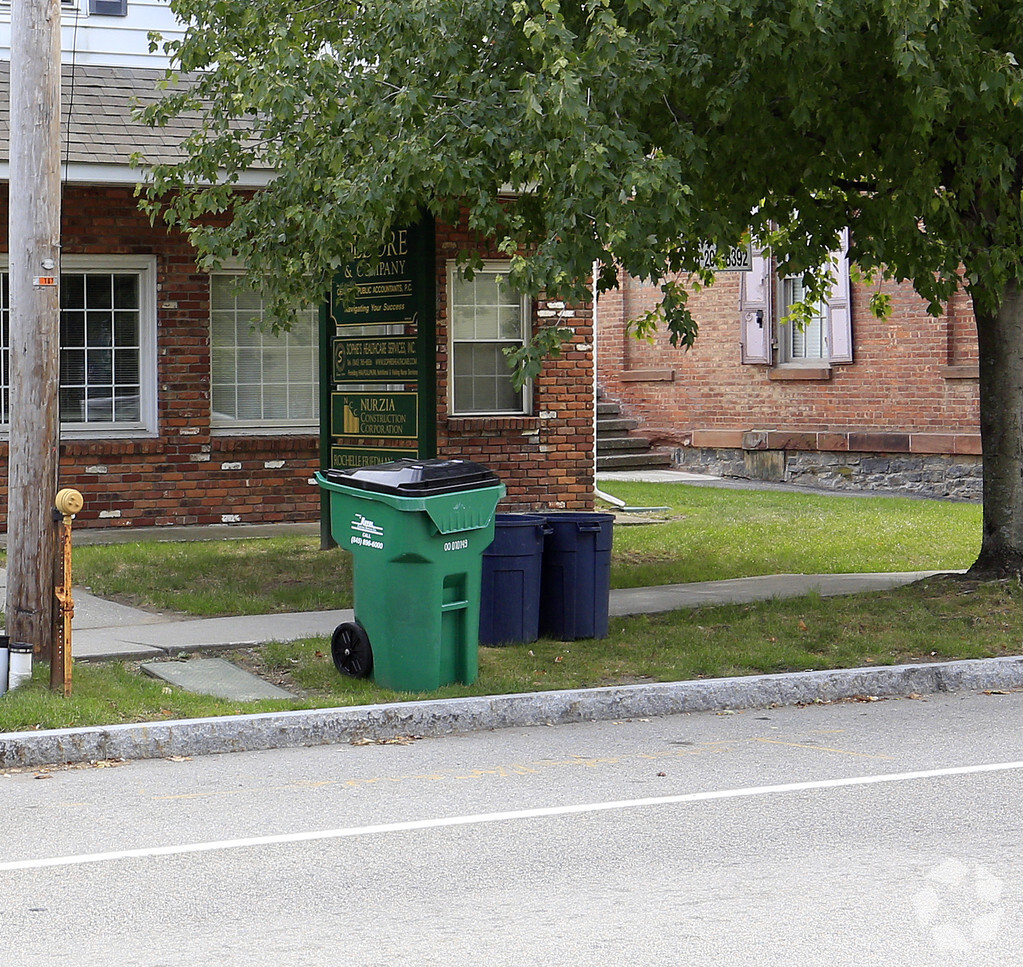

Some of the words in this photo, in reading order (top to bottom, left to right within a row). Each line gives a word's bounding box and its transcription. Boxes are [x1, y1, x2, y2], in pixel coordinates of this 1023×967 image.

[344, 264, 353, 278] &
[357, 285, 372, 295] PUBLIC
[371, 303, 382, 312] Your
[383, 302, 406, 312] Success
[360, 398, 396, 412] NURZIA
[360, 412, 407, 423] CONSTRUCTION
[360, 422, 403, 434] CORPORATION
[333, 454, 362, 467] ROCHELLE
